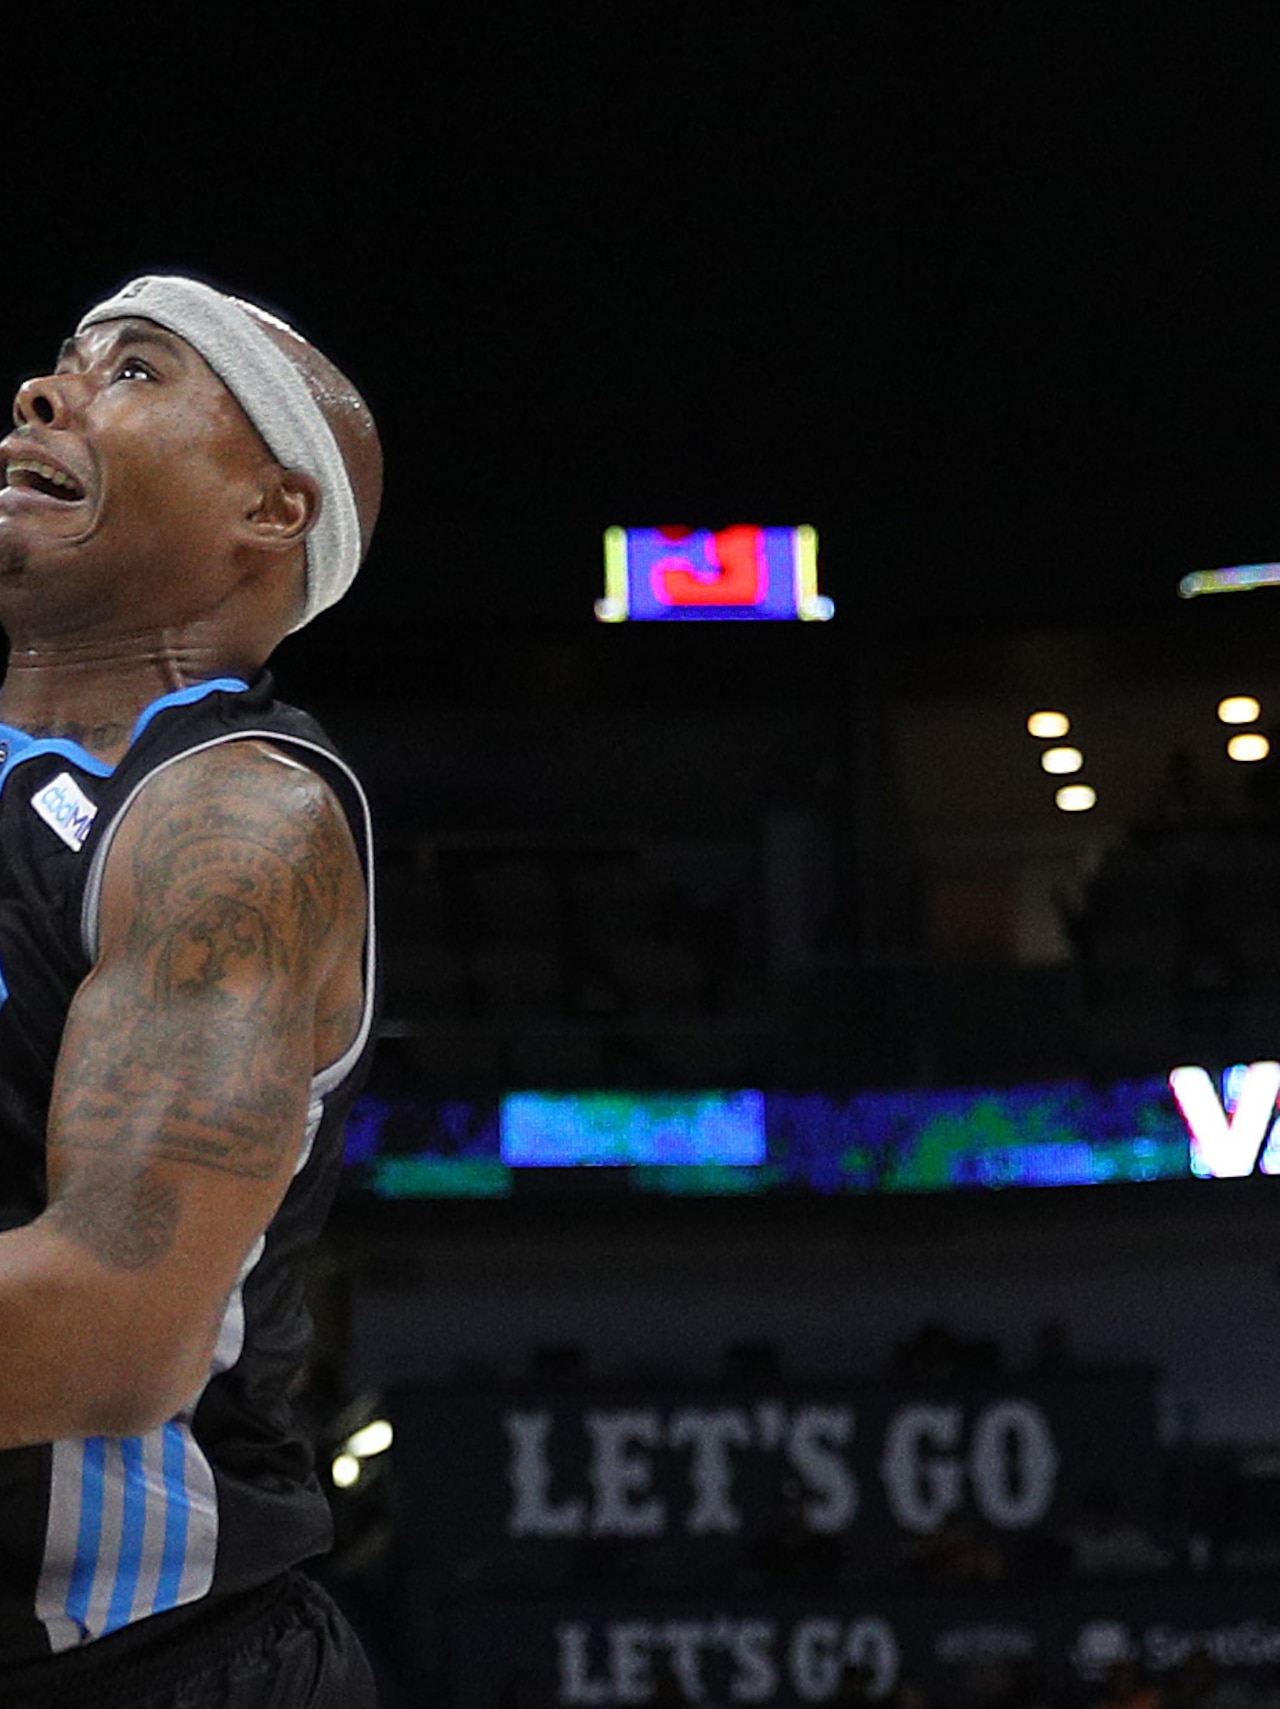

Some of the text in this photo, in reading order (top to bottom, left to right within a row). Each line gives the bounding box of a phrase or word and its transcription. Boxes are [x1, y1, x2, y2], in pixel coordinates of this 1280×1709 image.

[504, 1399, 1061, 1538] LET'S GO
[788, 1614, 903, 1703] GO
